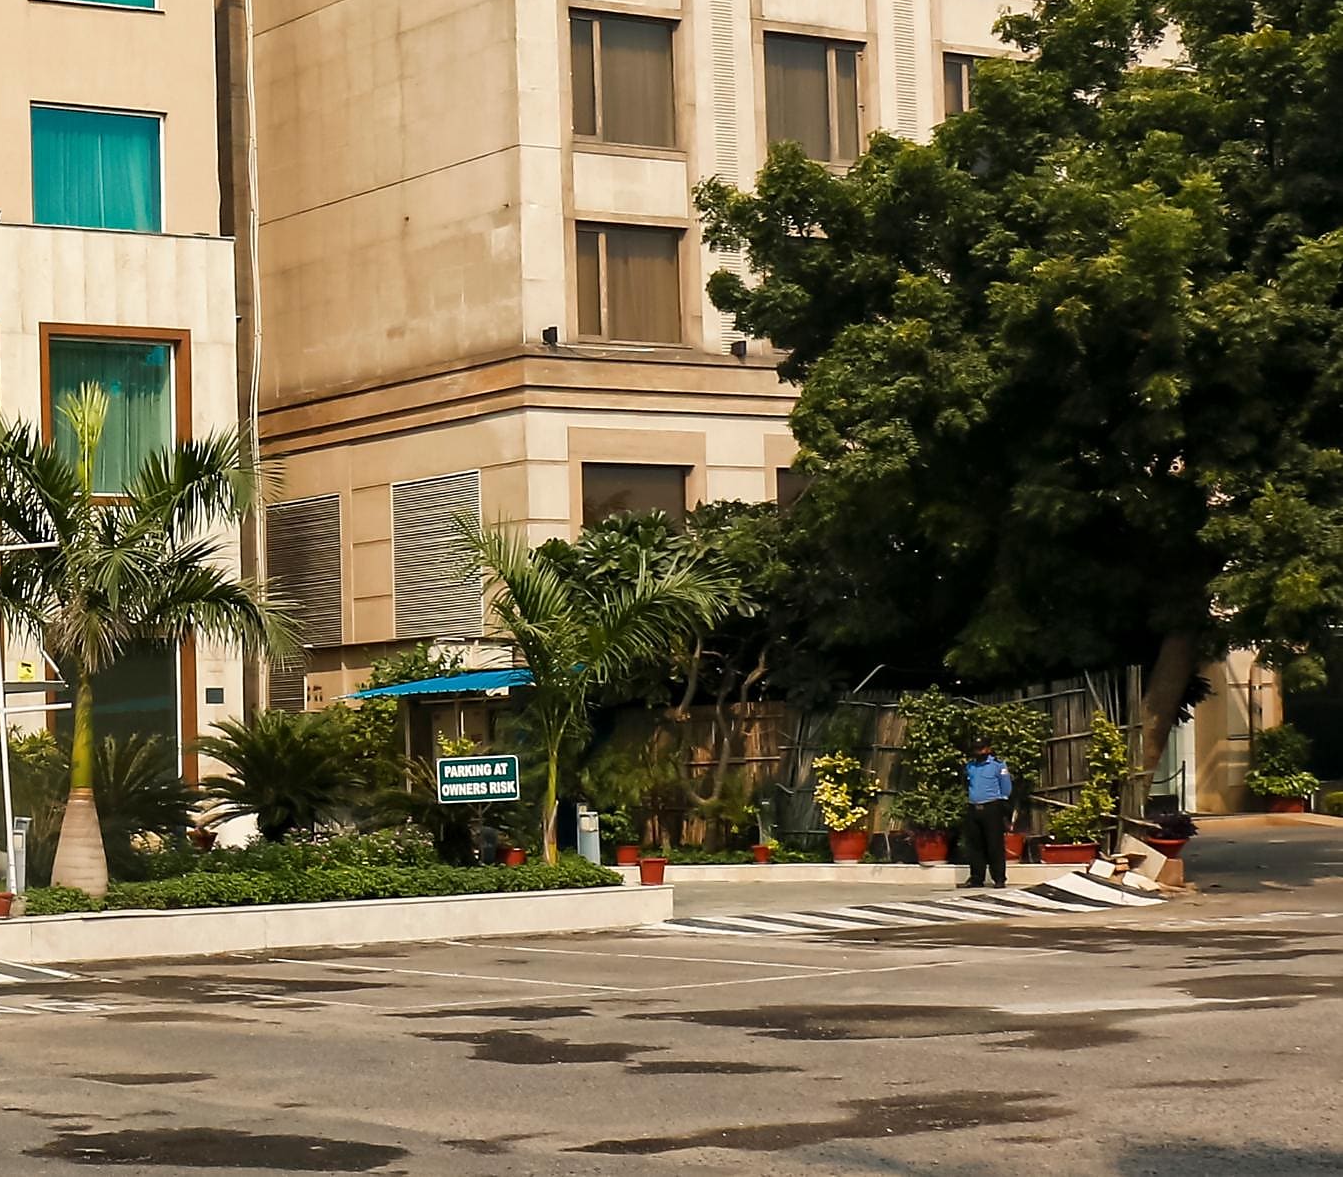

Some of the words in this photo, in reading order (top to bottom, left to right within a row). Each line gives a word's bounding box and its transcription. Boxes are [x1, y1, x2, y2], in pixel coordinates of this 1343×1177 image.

[444, 764, 492, 778] PARKING
[493, 763, 508, 775] AT
[441, 781, 488, 796] OWNERS
[489, 780, 516, 794] RISK
